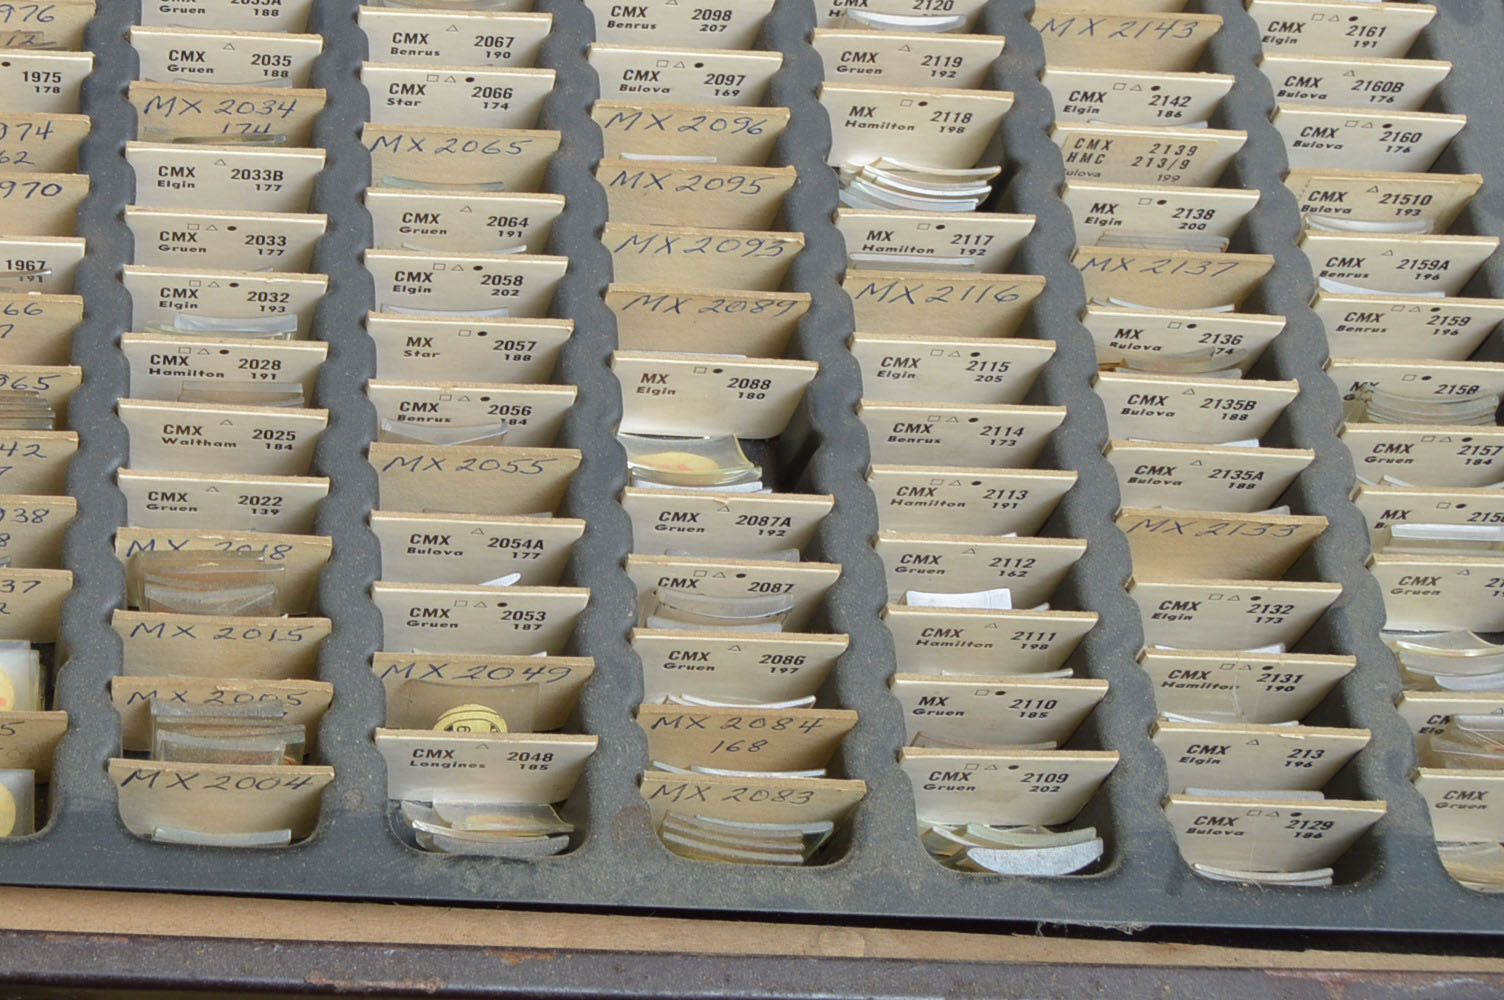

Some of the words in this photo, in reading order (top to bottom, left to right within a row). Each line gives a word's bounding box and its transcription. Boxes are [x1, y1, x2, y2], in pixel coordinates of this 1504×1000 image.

[159, 5, 205, 14] Gruen
[254, 8, 279, 16] 188
[1268, 21, 1306, 33] CMX
[1346, 25, 1386, 37] 2161
[1262, 36, 1298, 45] Elgin
[1354, 40, 1377, 48] 191
[23, 71, 61, 83] 1975
[623, 69, 660, 82] CMX
[704, 73, 746, 86] 2097
[389, 83, 426, 95] CMX
[472, 86, 513, 99] 2066
[619, 84, 670, 93] Bulova
[387, 98, 421, 106] Star
[484, 102, 508, 110] 174
[849, 106, 876, 118] MX
[930, 111, 973, 124] 2118
[845, 120, 915, 130] Hamilton
[1300, 126, 1339, 138] CMX
[1379, 131, 1422, 143] 2160
[1293, 140, 1343, 149] Bulova
[159, 166, 195, 178] CMX
[231, 169, 283, 181] 2033B
[158, 180, 195, 189] Elgin
[610, 170, 668, 190] MX
[675, 174, 770, 194] 2095
[641, 373, 669, 384] MX
[727, 378, 771, 390] 2088
[636, 386, 676, 396] Elgin
[1127, 394, 1168, 406] CMX
[1200, 398, 1257, 410] 2135B
[1121, 408, 1175, 417] Bulova
[1222, 413, 1248, 421] 188
[163, 424, 202, 436] CMX
[252, 429, 296, 441] 2025
[893, 423, 933, 433] CMX
[980, 426, 1024, 436] 2114
[162, 437, 236, 447] Waltham
[651, 713, 711, 730] MX
[720, 717, 824, 734] 2084
[710, 739, 768, 754] 168
[413, 749, 455, 759] CMX
[507, 752, 553, 762] 2048
[410, 760, 485, 768] Longines
[120, 769, 196, 790] MX
[203, 773, 313, 791] 2004
[929, 771, 972, 781] CMX
[1021, 773, 1069, 783] 2109
